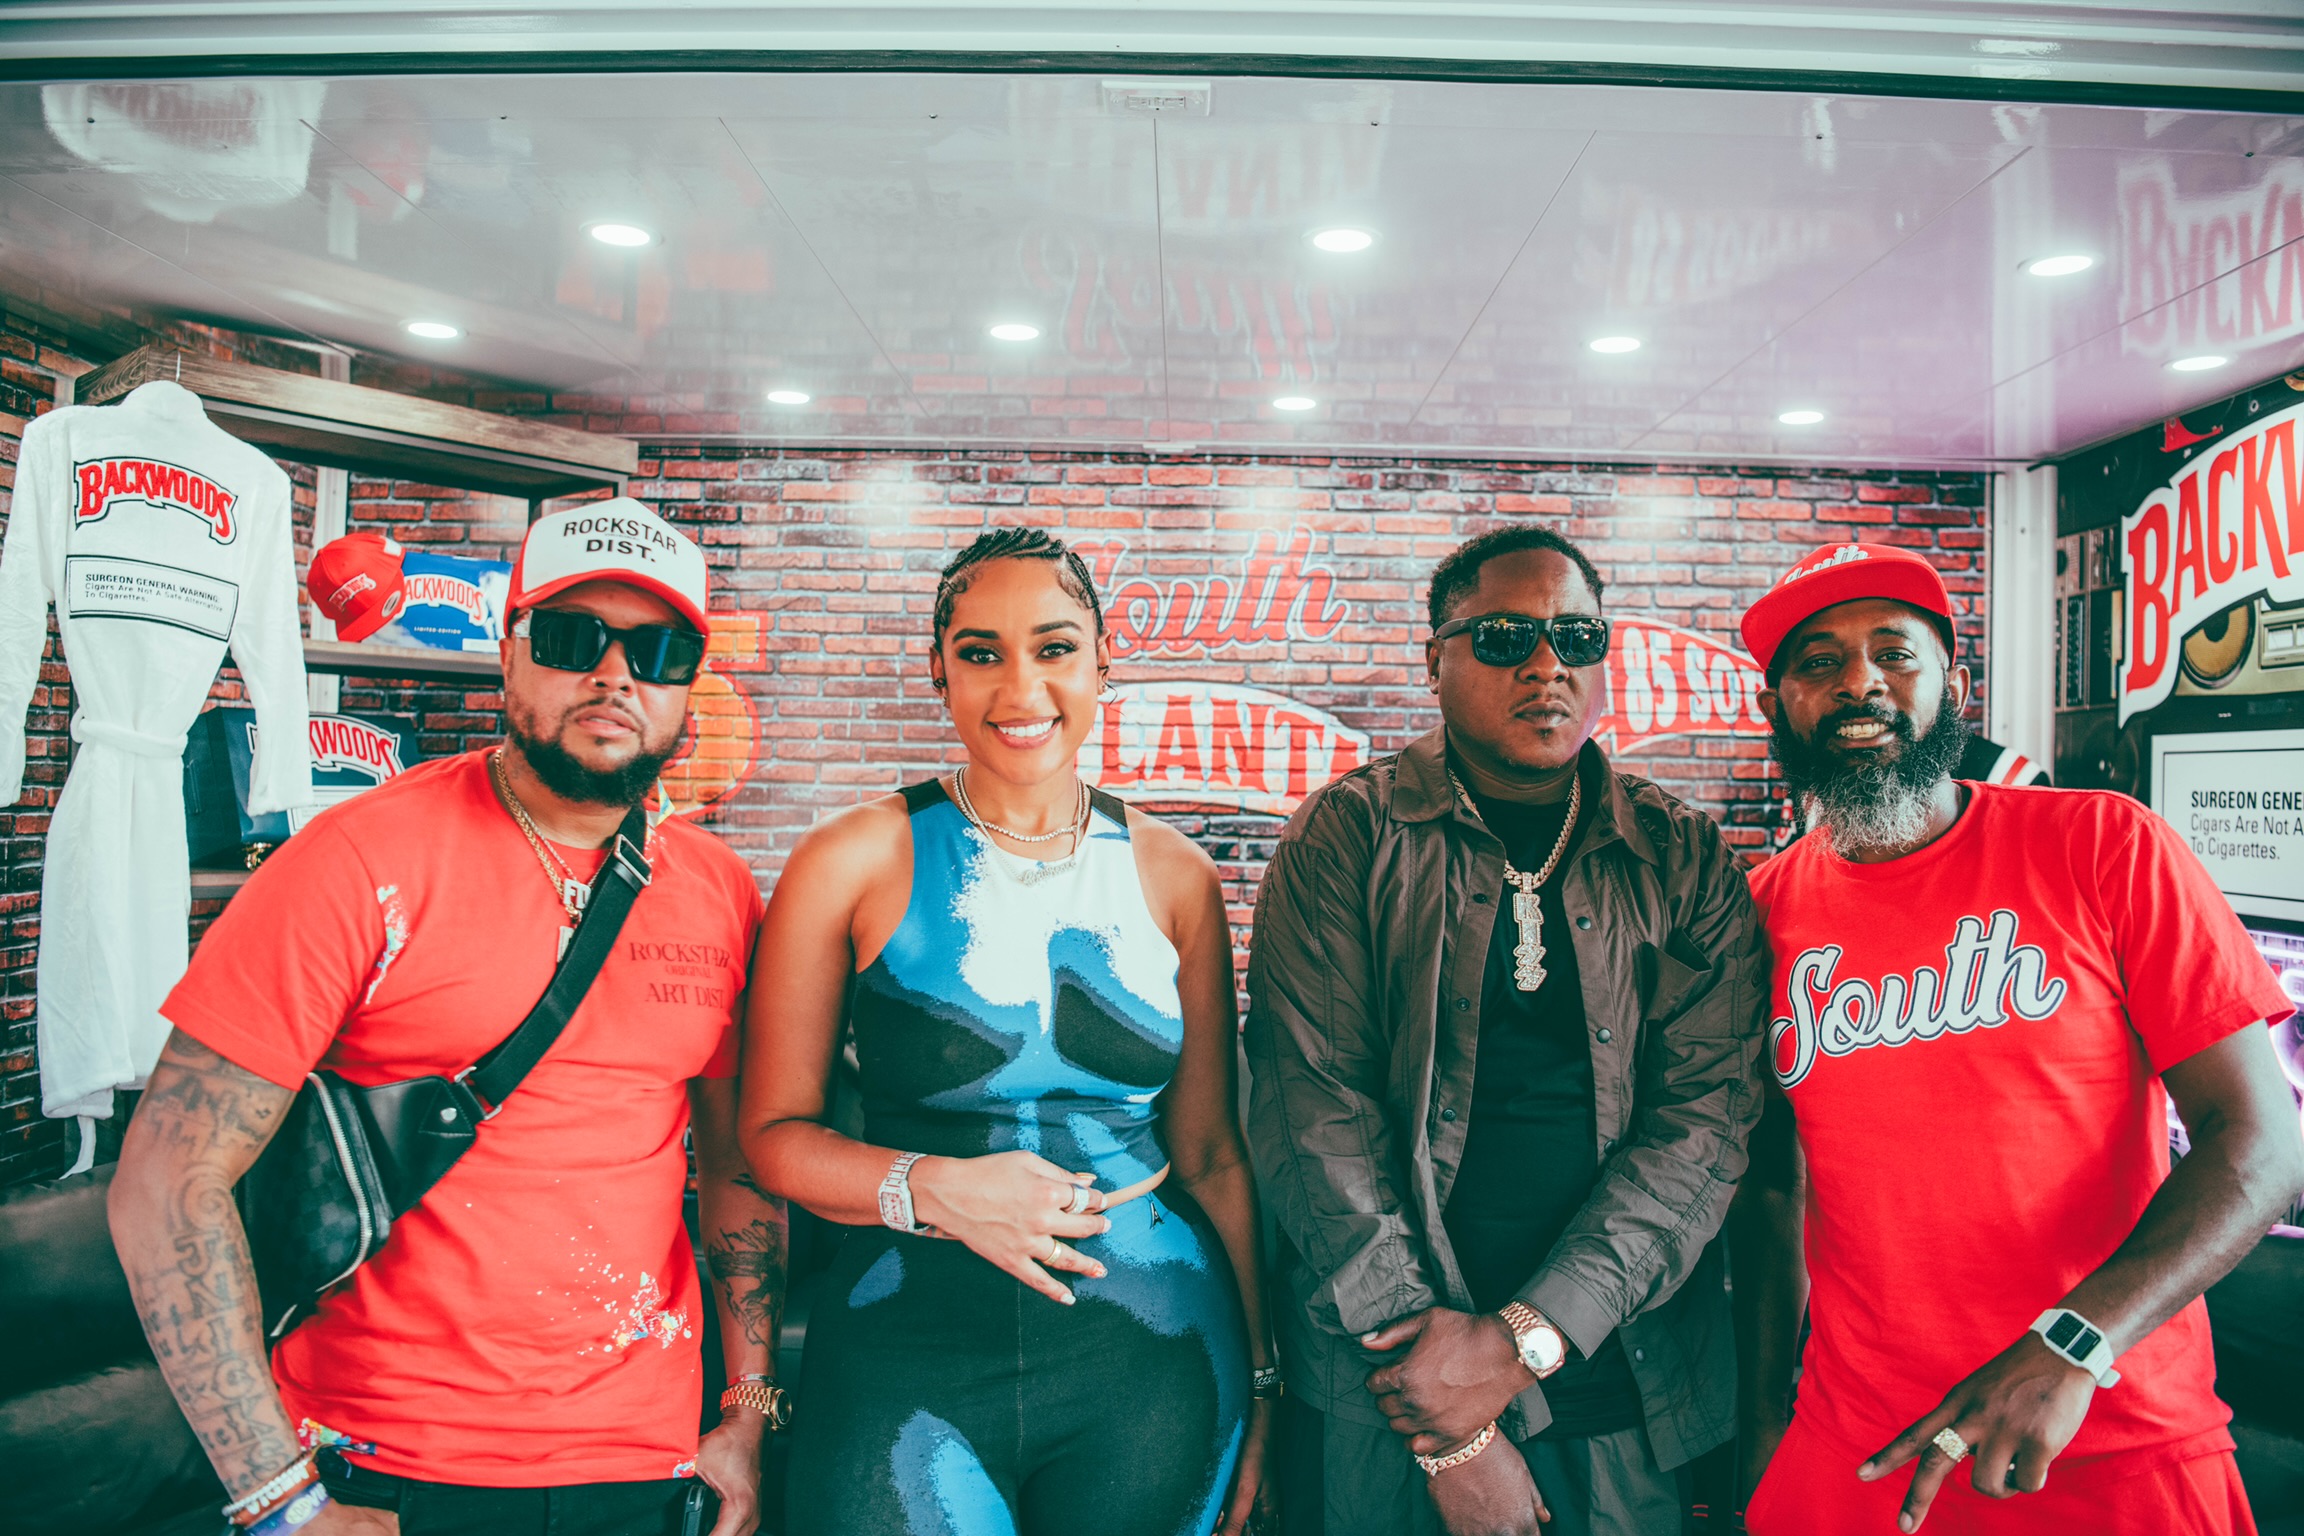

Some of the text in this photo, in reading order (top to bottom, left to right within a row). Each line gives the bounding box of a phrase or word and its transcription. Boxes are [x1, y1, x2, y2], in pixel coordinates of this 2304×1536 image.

[79, 461, 235, 538] BACKWOODS
[563, 517, 677, 555] ROCKSTAR
[586, 539, 656, 562] DIST.
[85, 583, 114, 591] Cigars
[137, 587, 152, 595] Not
[85, 591, 96, 599] To
[86, 574, 133, 584] SURGEON
[136, 578, 176, 591] GENERAL
[405, 577, 483, 621] ACKWOODS
[1623, 627, 1678, 734] 85
[1684, 641, 1768, 726] SOU
[309, 720, 397, 780] KWOODS
[2191, 790, 2304, 810] SURGEON GENE
[2191, 813, 2304, 836] Cigars Are Not A
[2191, 836, 2280, 861] To Cigarettes.
[629, 942, 730, 968] ROCKSTAR
[645, 982, 689, 1004] ART
[1768, 908, 2067, 1090] South
